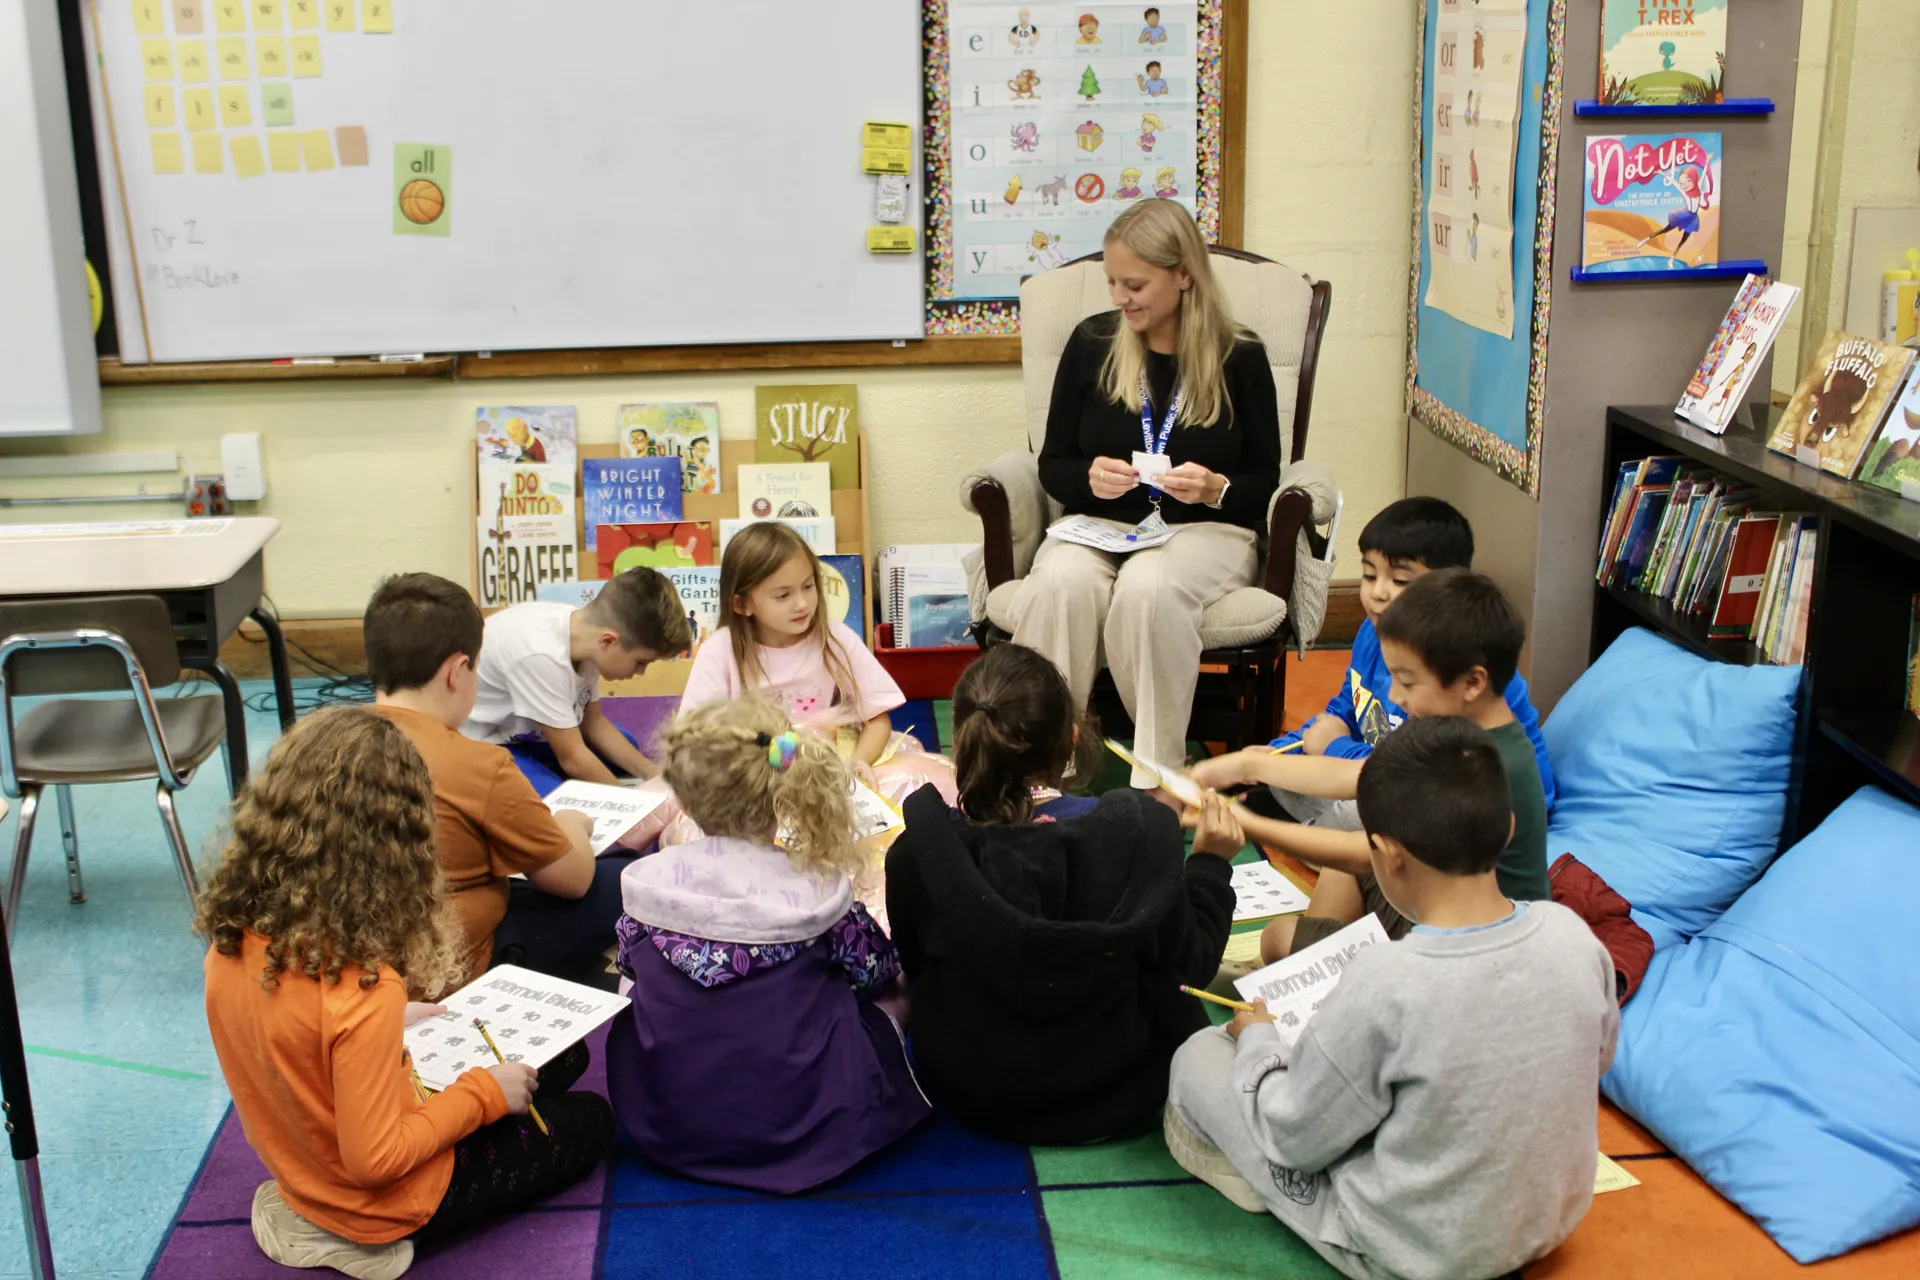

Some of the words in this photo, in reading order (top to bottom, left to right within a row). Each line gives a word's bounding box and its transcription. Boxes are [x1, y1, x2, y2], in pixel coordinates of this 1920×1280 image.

[334, 6, 345, 21] y
[371, 6, 382, 17] z
[1637, 9, 1652, 26] T.
[1658, 9, 1695, 26] REX
[968, 34, 984, 52] e
[1441, 43, 1456, 67] or
[973, 85, 981, 107] i
[1438, 104, 1452, 128] er
[410, 150, 434, 174] all
[970, 144, 986, 162] o
[1438, 157, 1450, 188] ir
[971, 198, 987, 215] u
[1434, 222, 1451, 248] ur
[971, 251, 988, 274] y
[1750, 301, 1780, 327] MEMORY
[1736, 325, 1758, 345] JARS
[1835, 340, 1886, 369] BUFFALO
[1824, 357, 1878, 389] FLUFFALO
[769, 401, 850, 446] STUCK
[1160, 412, 1178, 441] Public
[515, 472, 538, 494] DO
[600, 469, 661, 484] BRIGHT
[755, 474, 763, 483] A
[765, 472, 796, 483] Friend
[799, 472, 813, 482] for
[597, 486, 665, 500] WINTER
[767, 484, 801, 498] Henry
[503, 496, 550, 516] UNTO
[602, 503, 662, 517] NIGHT
[671, 574, 707, 585] Gifts
[709, 576, 720, 585] fr
[681, 587, 720, 600] Garb
[551, 796, 601, 809] ADDITION
[598, 799, 643, 814] BINGO!
[1258, 961, 1328, 1005] ADDITION
[483, 978, 550, 1002] ADDITION
[544, 992, 602, 1015] BINGO!
[522, 1011, 541, 1022] 10
[499, 1028, 519, 1039] 12
